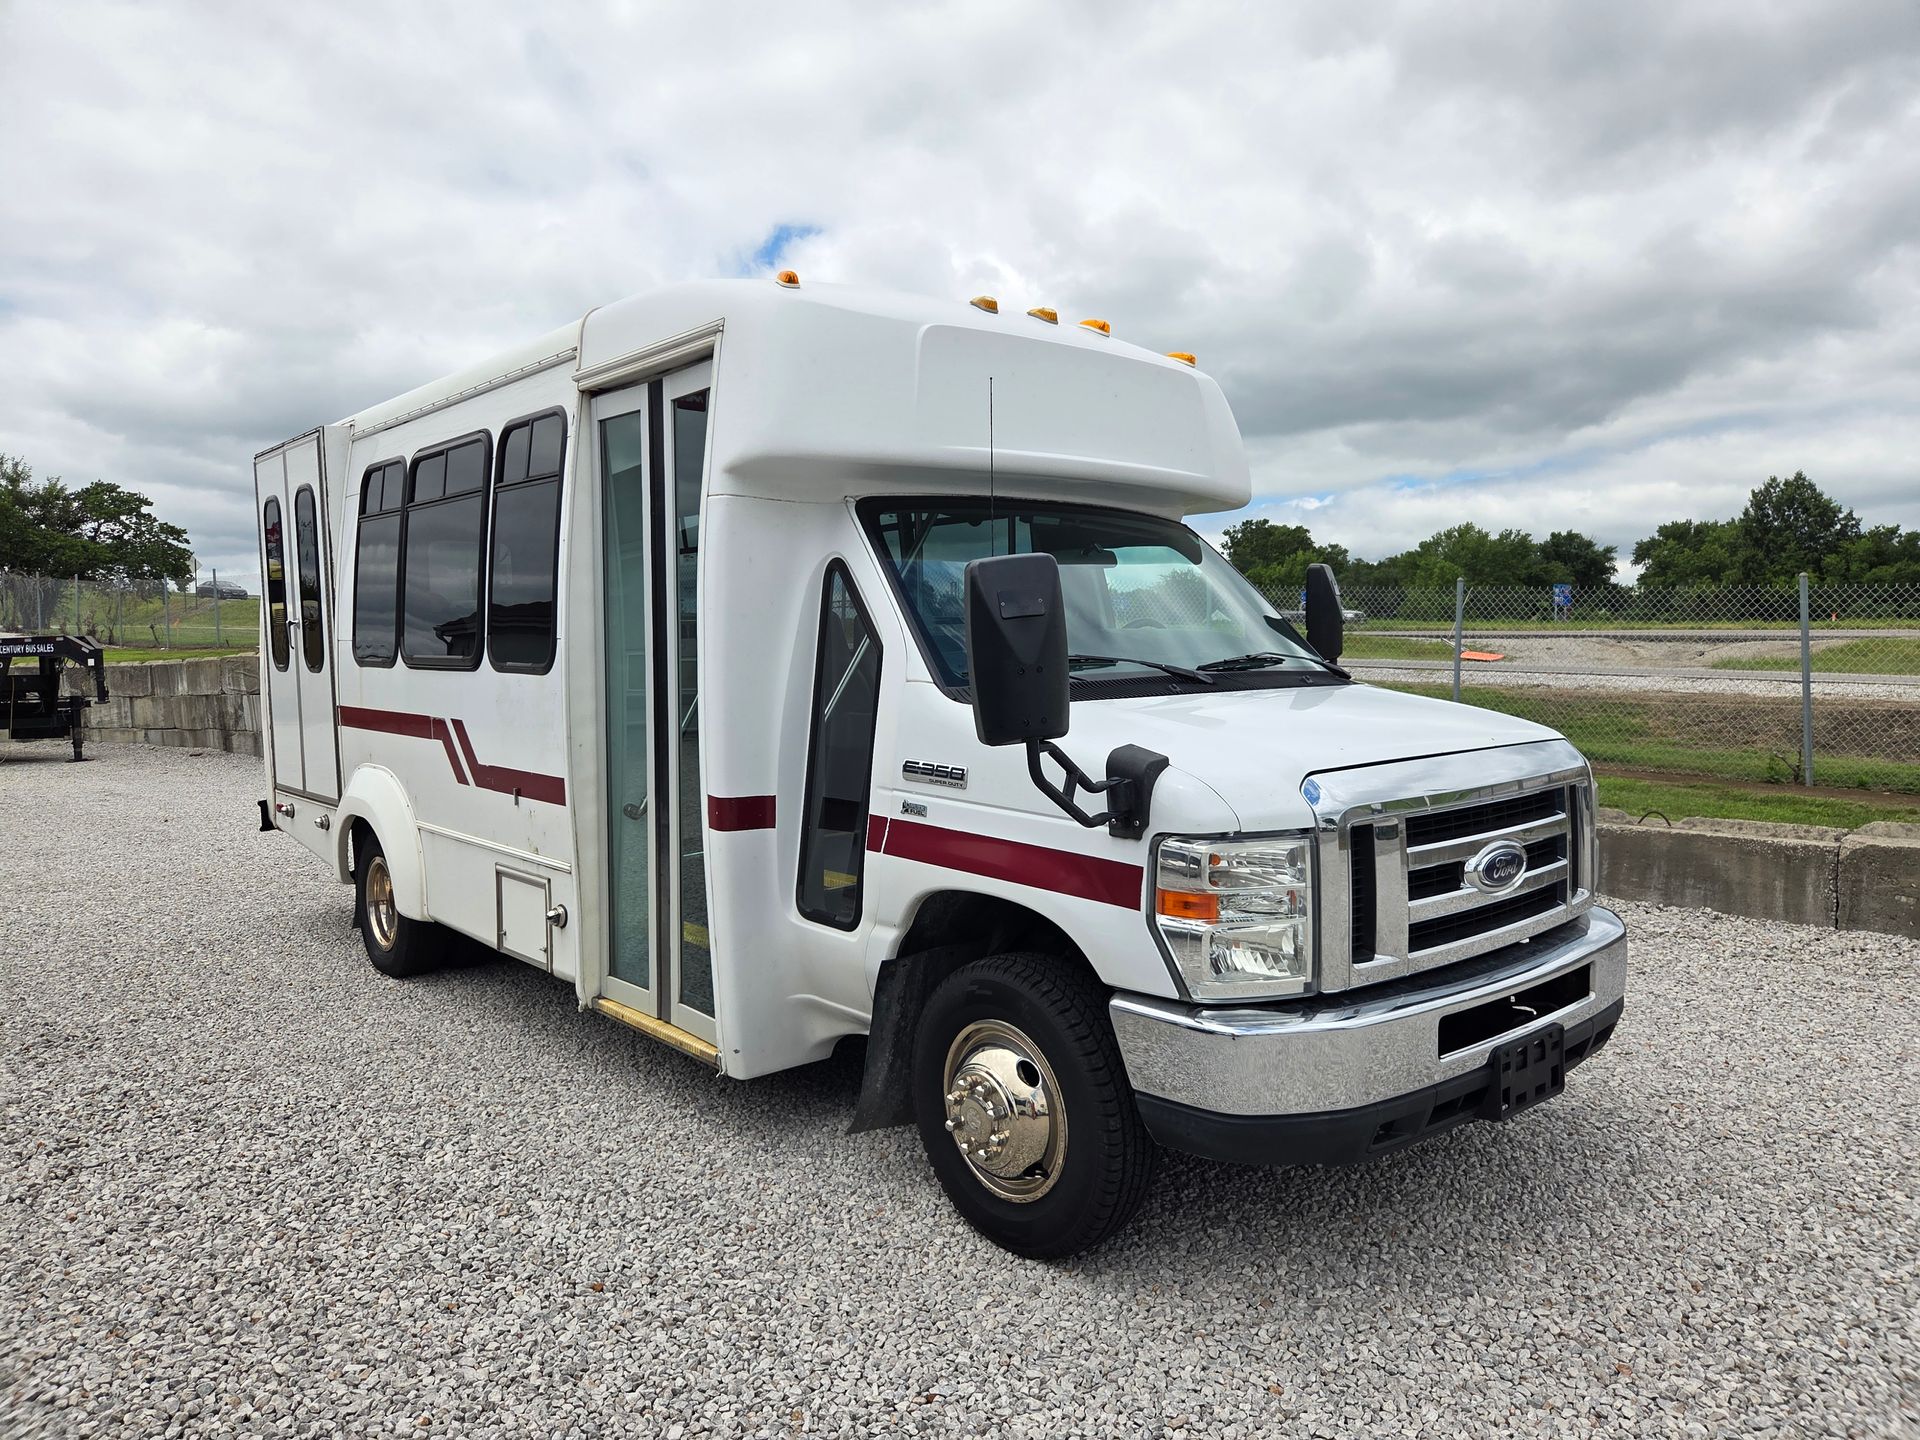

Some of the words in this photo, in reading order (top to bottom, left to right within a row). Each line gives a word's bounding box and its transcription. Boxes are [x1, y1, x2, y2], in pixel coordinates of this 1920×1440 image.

[25, 644, 36, 653] BUS
[37, 643, 54, 652] SALES
[1493, 855, 1518, 878] Ford
